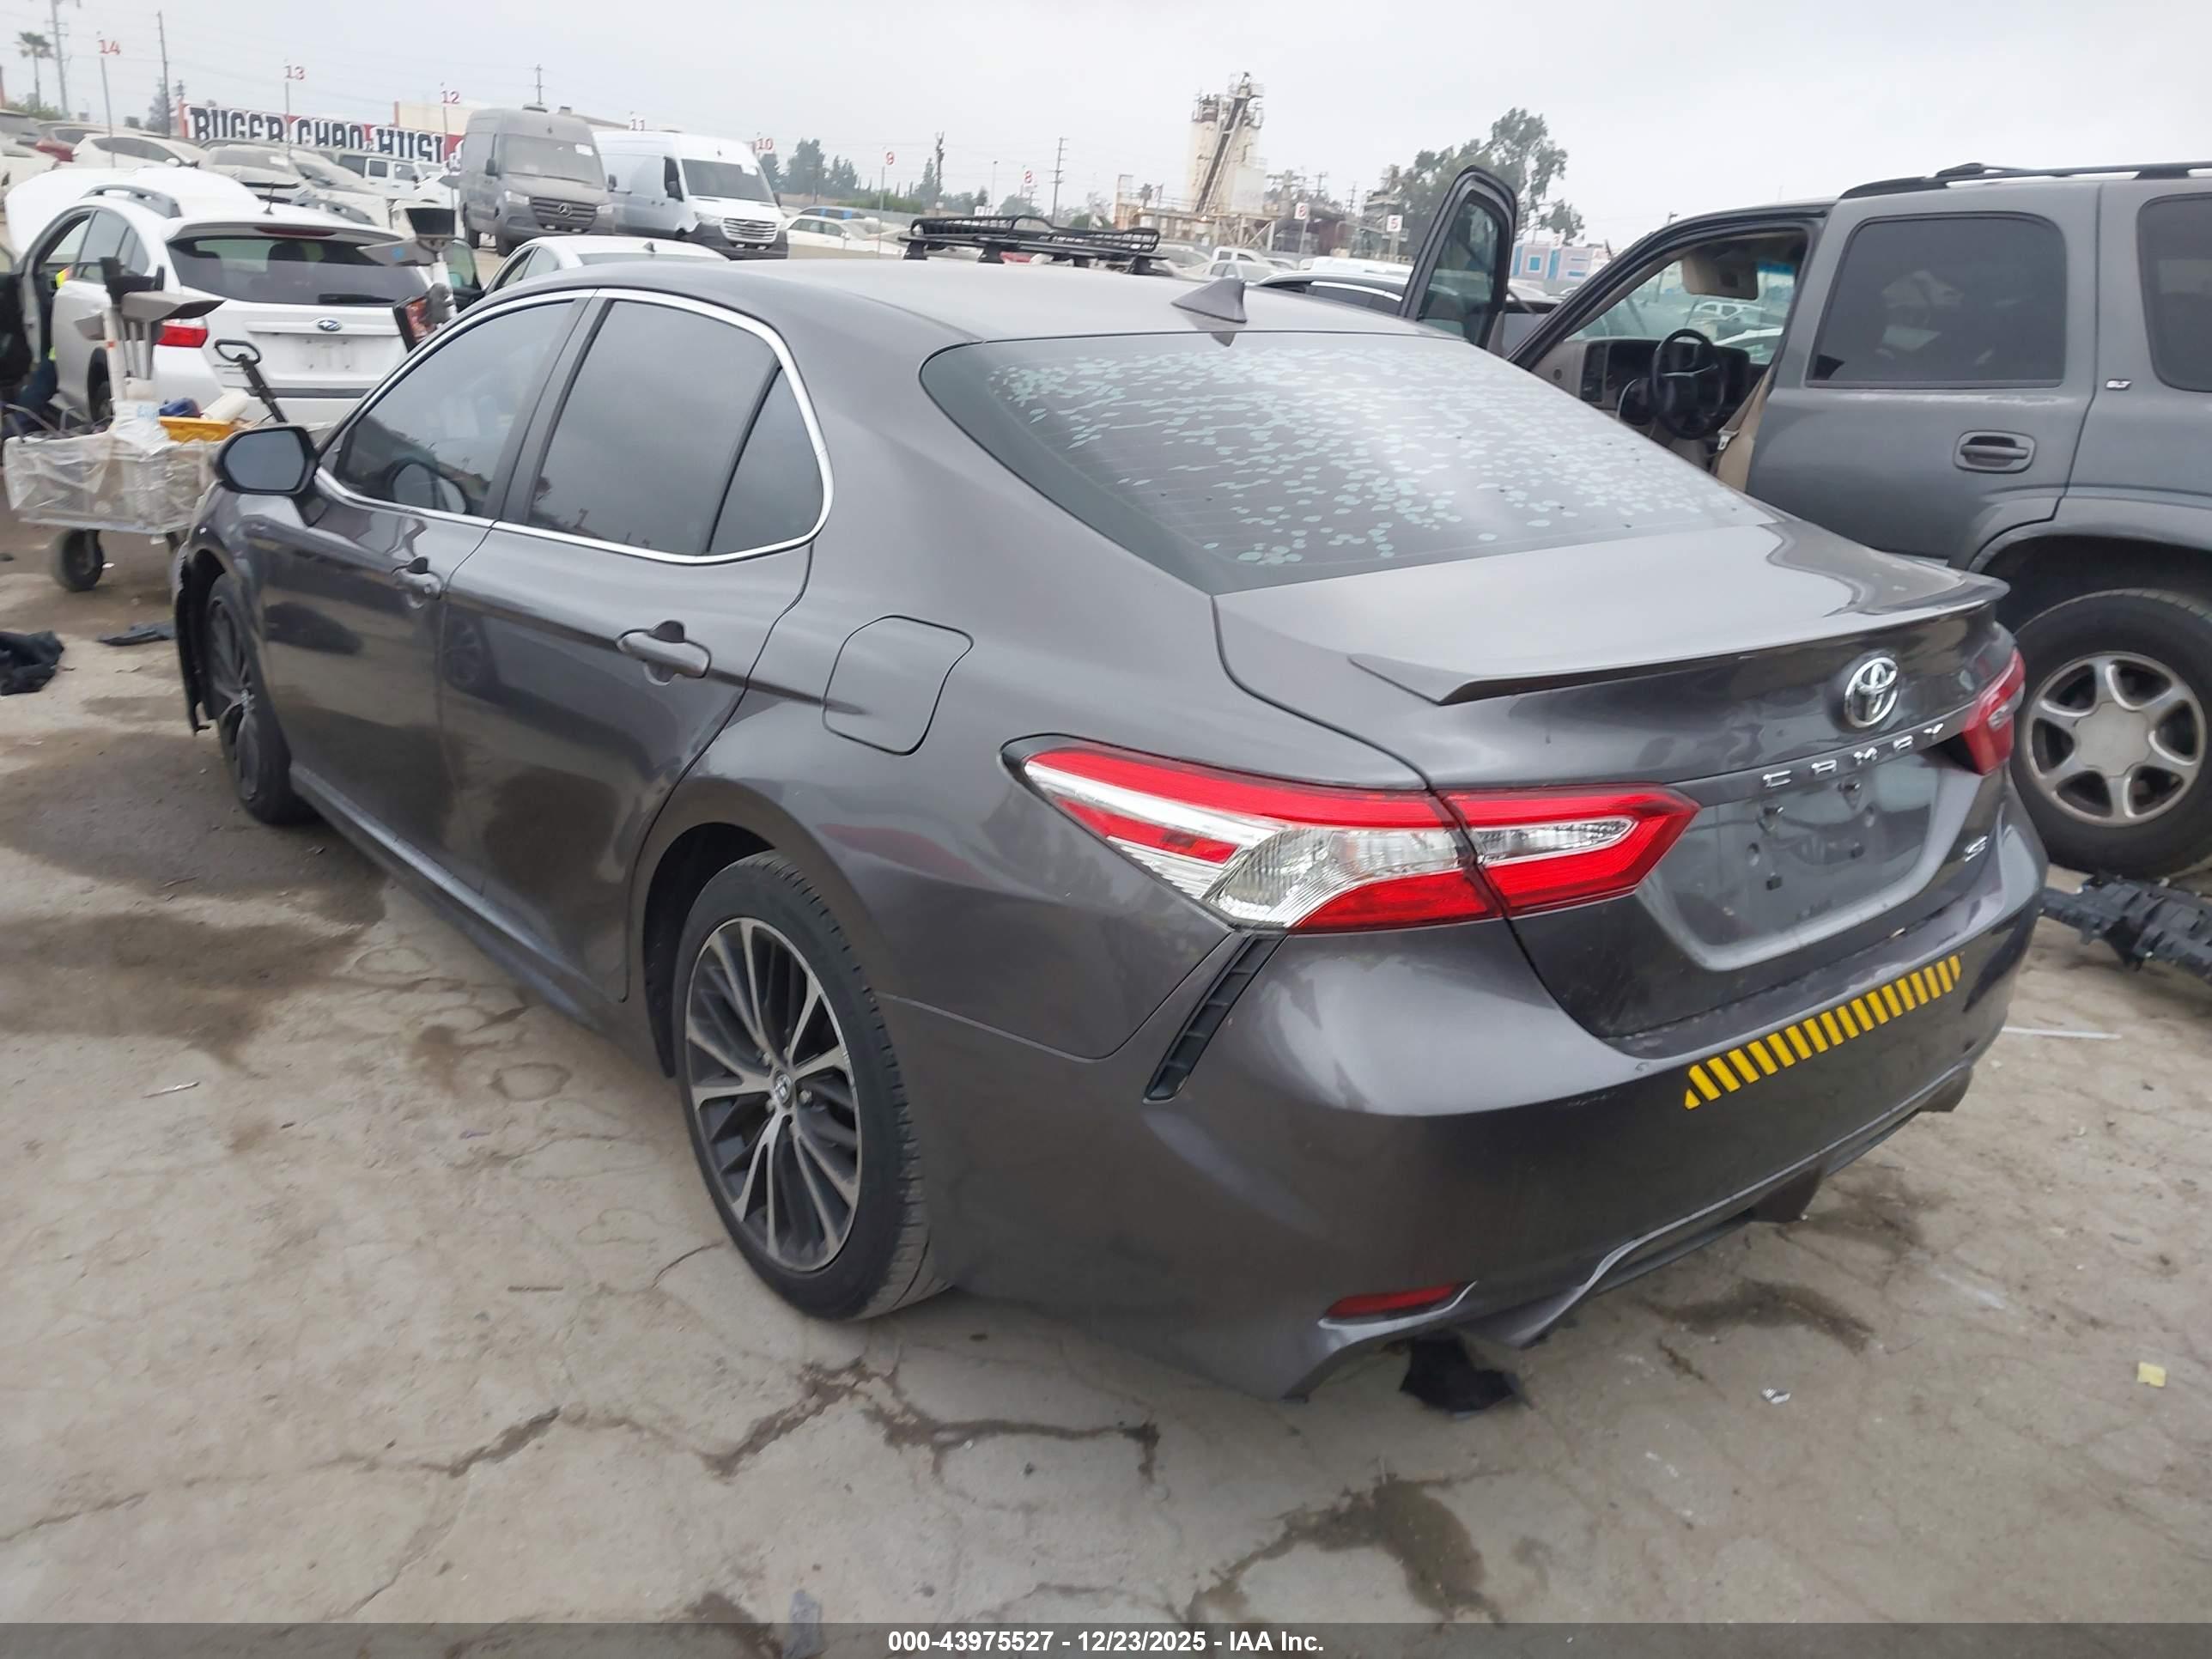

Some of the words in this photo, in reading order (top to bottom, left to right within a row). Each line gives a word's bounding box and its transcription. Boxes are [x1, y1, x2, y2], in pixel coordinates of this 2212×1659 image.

[98, 39, 120, 55] 14
[284, 64, 305, 81] 13
[440, 89, 460, 105] 12
[629, 118, 645, 131] 11
[757, 137, 774, 150] 10
[1390, 216, 1399, 229] 5
[1762, 722, 1944, 788] CAMRY
